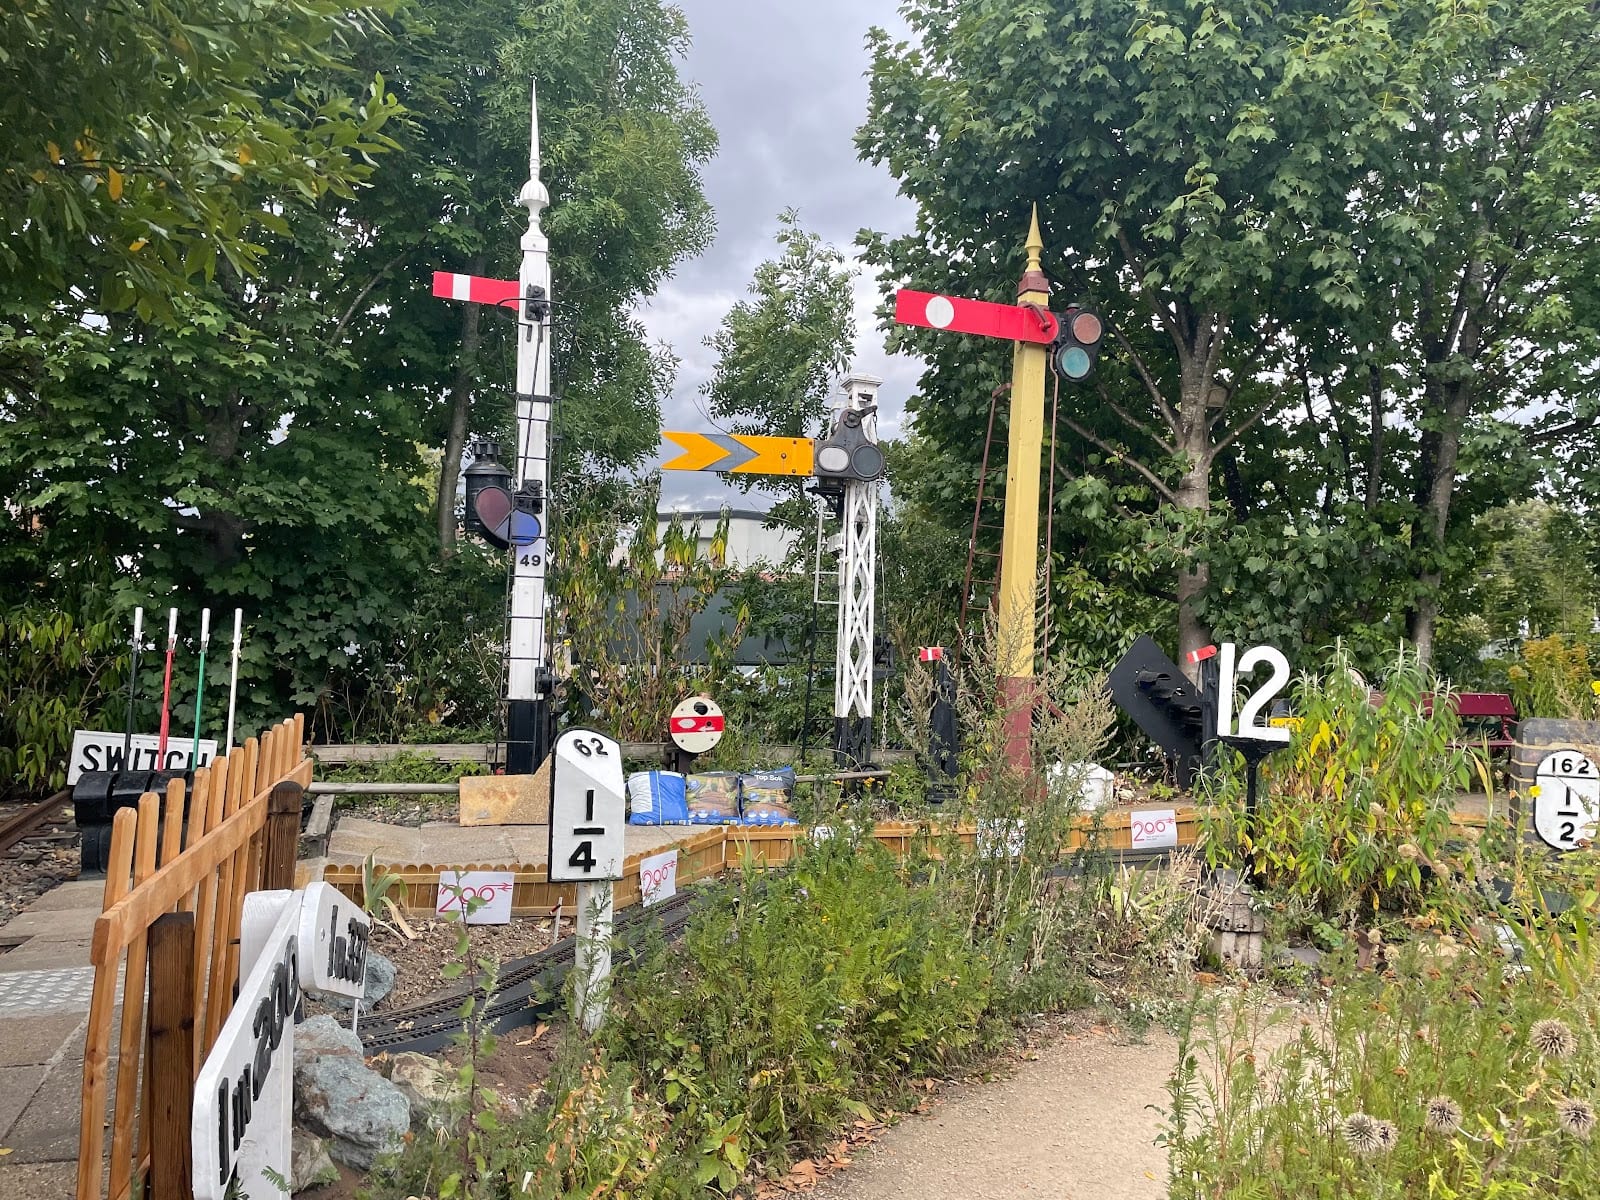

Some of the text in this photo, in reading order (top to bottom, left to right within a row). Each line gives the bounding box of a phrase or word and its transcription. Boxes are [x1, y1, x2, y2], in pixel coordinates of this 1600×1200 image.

[519, 554, 541, 567] 49
[1217, 642, 1291, 742] 12
[573, 737, 609, 757] 62
[78, 744, 208, 773] SWITCH
[1551, 757, 1590, 775] 162
[1133, 820, 1166, 842] 200
[1559, 821, 1575, 842] 2
[568, 841, 597, 873] 4
[253, 934, 299, 1102] 200
